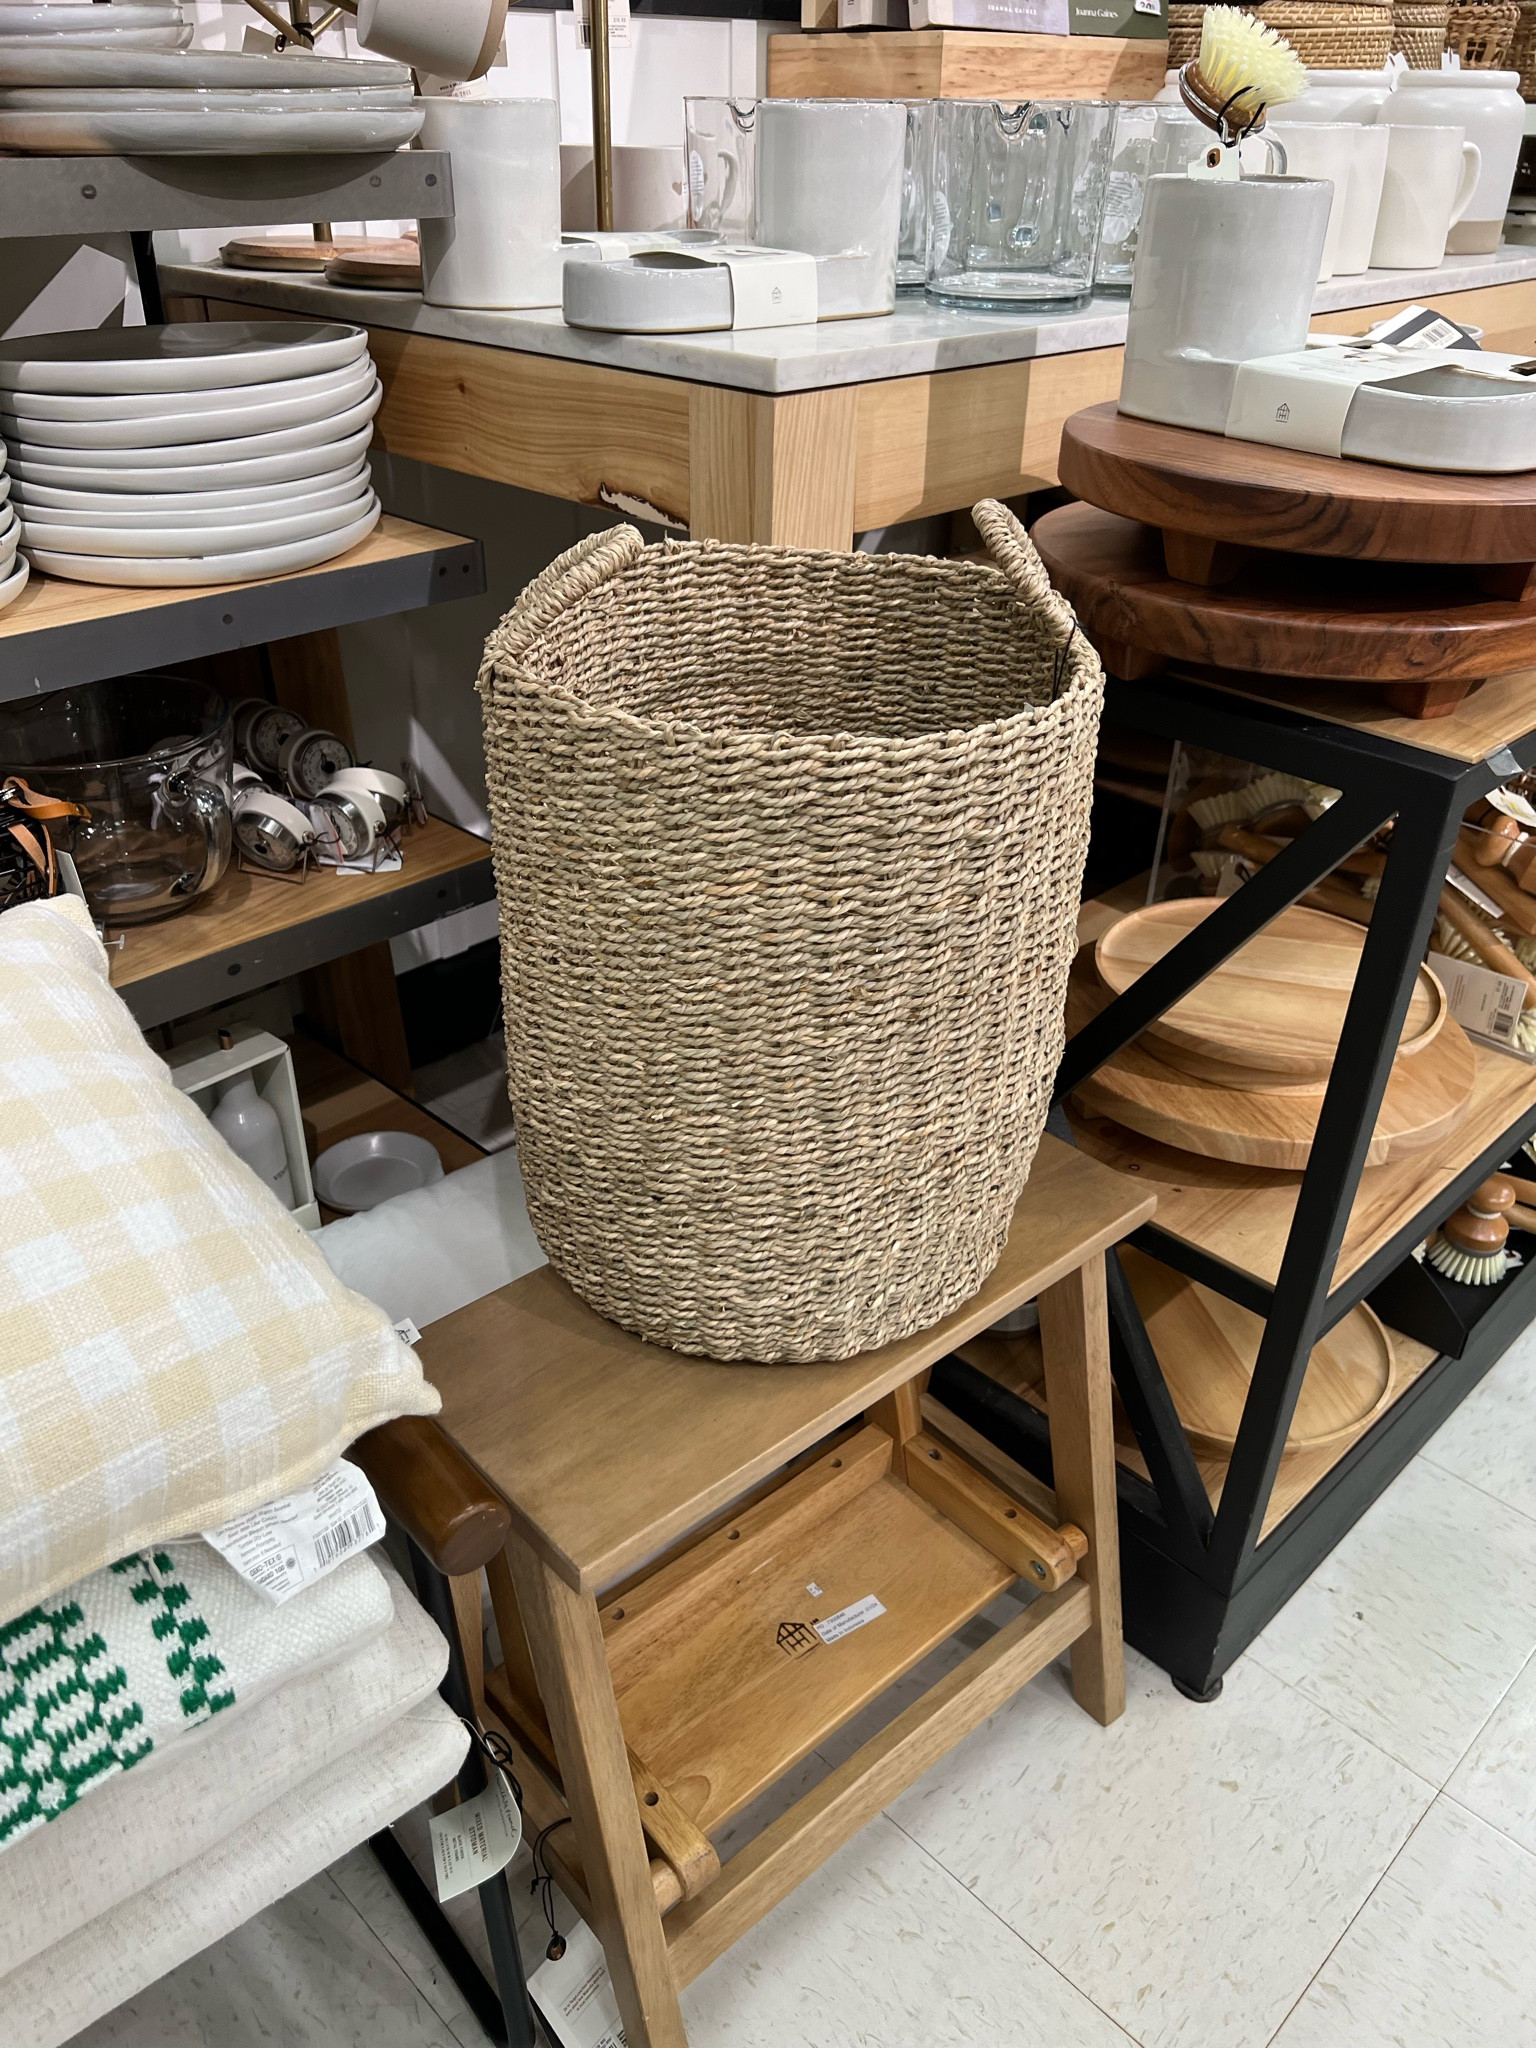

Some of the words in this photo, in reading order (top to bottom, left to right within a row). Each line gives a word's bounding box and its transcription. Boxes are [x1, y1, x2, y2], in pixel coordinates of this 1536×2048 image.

[988, 4, 1012, 13] JOANNA
[1015, 7, 1037, 16] GAINES
[1075, 7, 1097, 17] Joanna
[1097, 8, 1119, 18] Gaines
[821, 1627, 832, 1636] Date
[825, 1632, 839, 1642] Made
[843, 1618, 865, 1632] Indonesia
[473, 1811, 483, 1830] MIXED
[466, 1825, 480, 1855] OTTOMAN
[475, 1831, 490, 1862] MATERIAL
